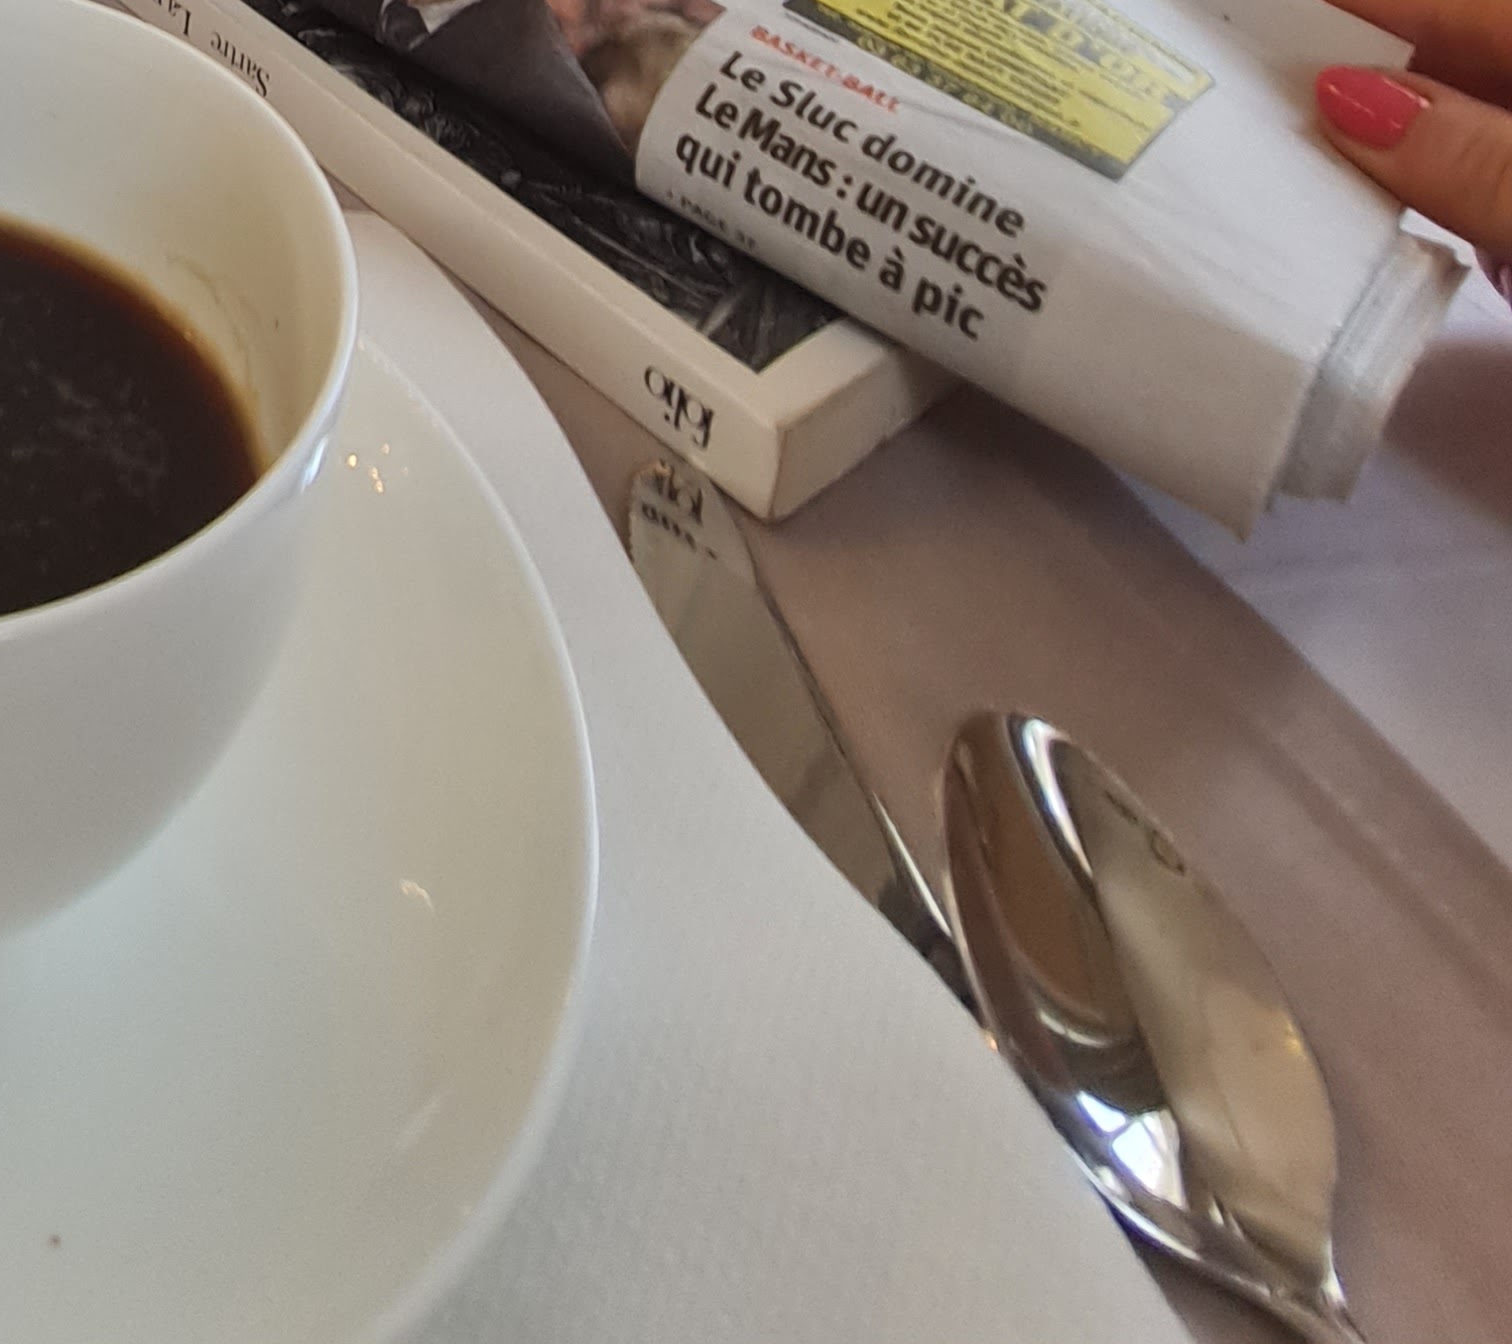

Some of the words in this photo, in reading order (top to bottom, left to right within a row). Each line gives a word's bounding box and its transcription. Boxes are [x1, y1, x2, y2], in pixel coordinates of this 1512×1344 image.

[210, 30, 271, 99] Sartre
[749, 24, 903, 113] BASKET-BALL
[695, 83, 740, 132] Le
[737, 107, 838, 188] Mans
[856, 180, 910, 233] un
[908, 211, 1049, 313] succès
[720, 50, 767, 92] Le
[769, 78, 860, 144] Sluc
[861, 133, 1027, 239] domine
[675, 132, 742, 189] qui
[743, 166, 873, 272] tombe
[878, 245, 906, 292] à
[911, 275, 986, 341] pic
[644, 365, 715, 452] folio
